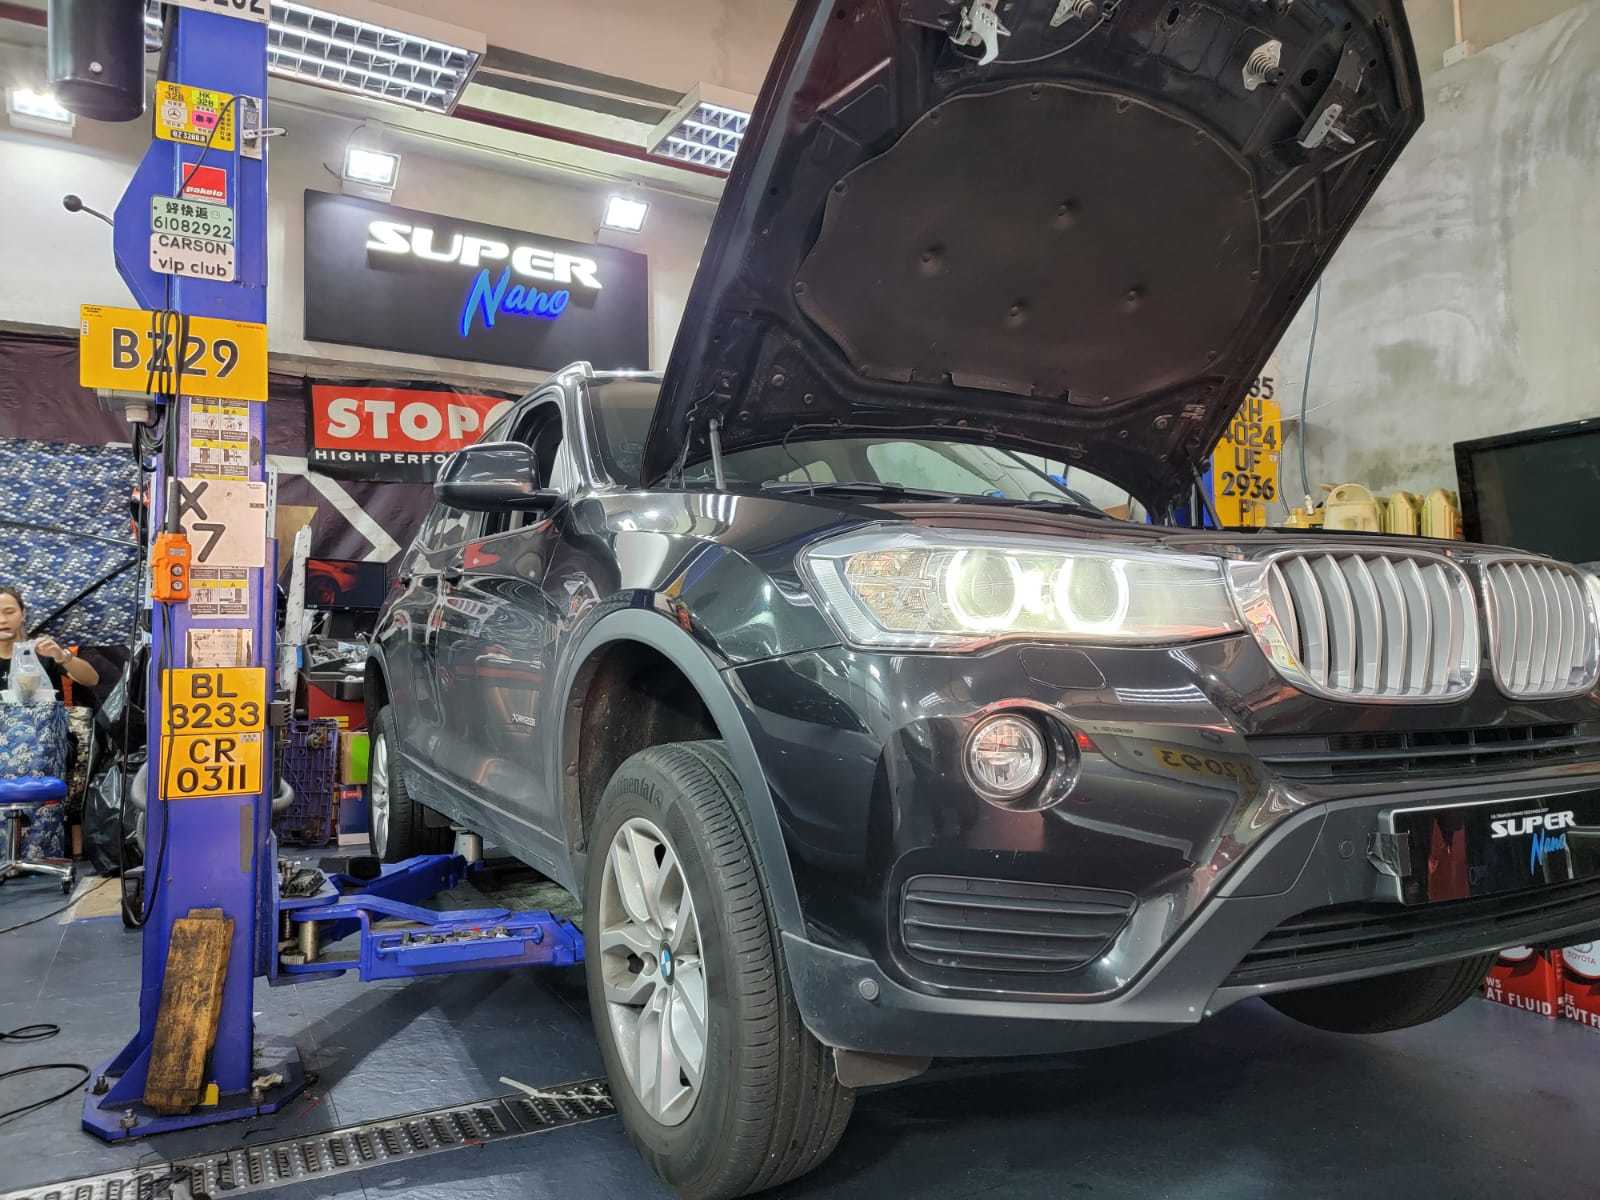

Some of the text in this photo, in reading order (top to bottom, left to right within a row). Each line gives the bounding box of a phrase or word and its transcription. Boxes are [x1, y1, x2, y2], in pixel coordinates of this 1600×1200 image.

[153, 216, 232, 239] 61082922
[158, 234, 227, 255] CARSON
[366, 220, 602, 289] SUPER
[159, 257, 227, 277] vip club
[460, 265, 570, 338] Nano
[315, 449, 367, 463] HIGH
[1221, 471, 1275, 500] 2936
[176, 480, 209, 520] X
[192, 523, 226, 563] 7
[191, 673, 238, 698] BL
[168, 702, 260, 729] 3233
[189, 737, 236, 764] CR
[177, 764, 247, 793] 0311
[1490, 810, 1576, 838] SUPER
[1530, 828, 1567, 876] Nano
[1486, 977, 1502, 988] WS
[1486, 987, 1504, 1002] AT
[1508, 993, 1552, 1015] FLUID
